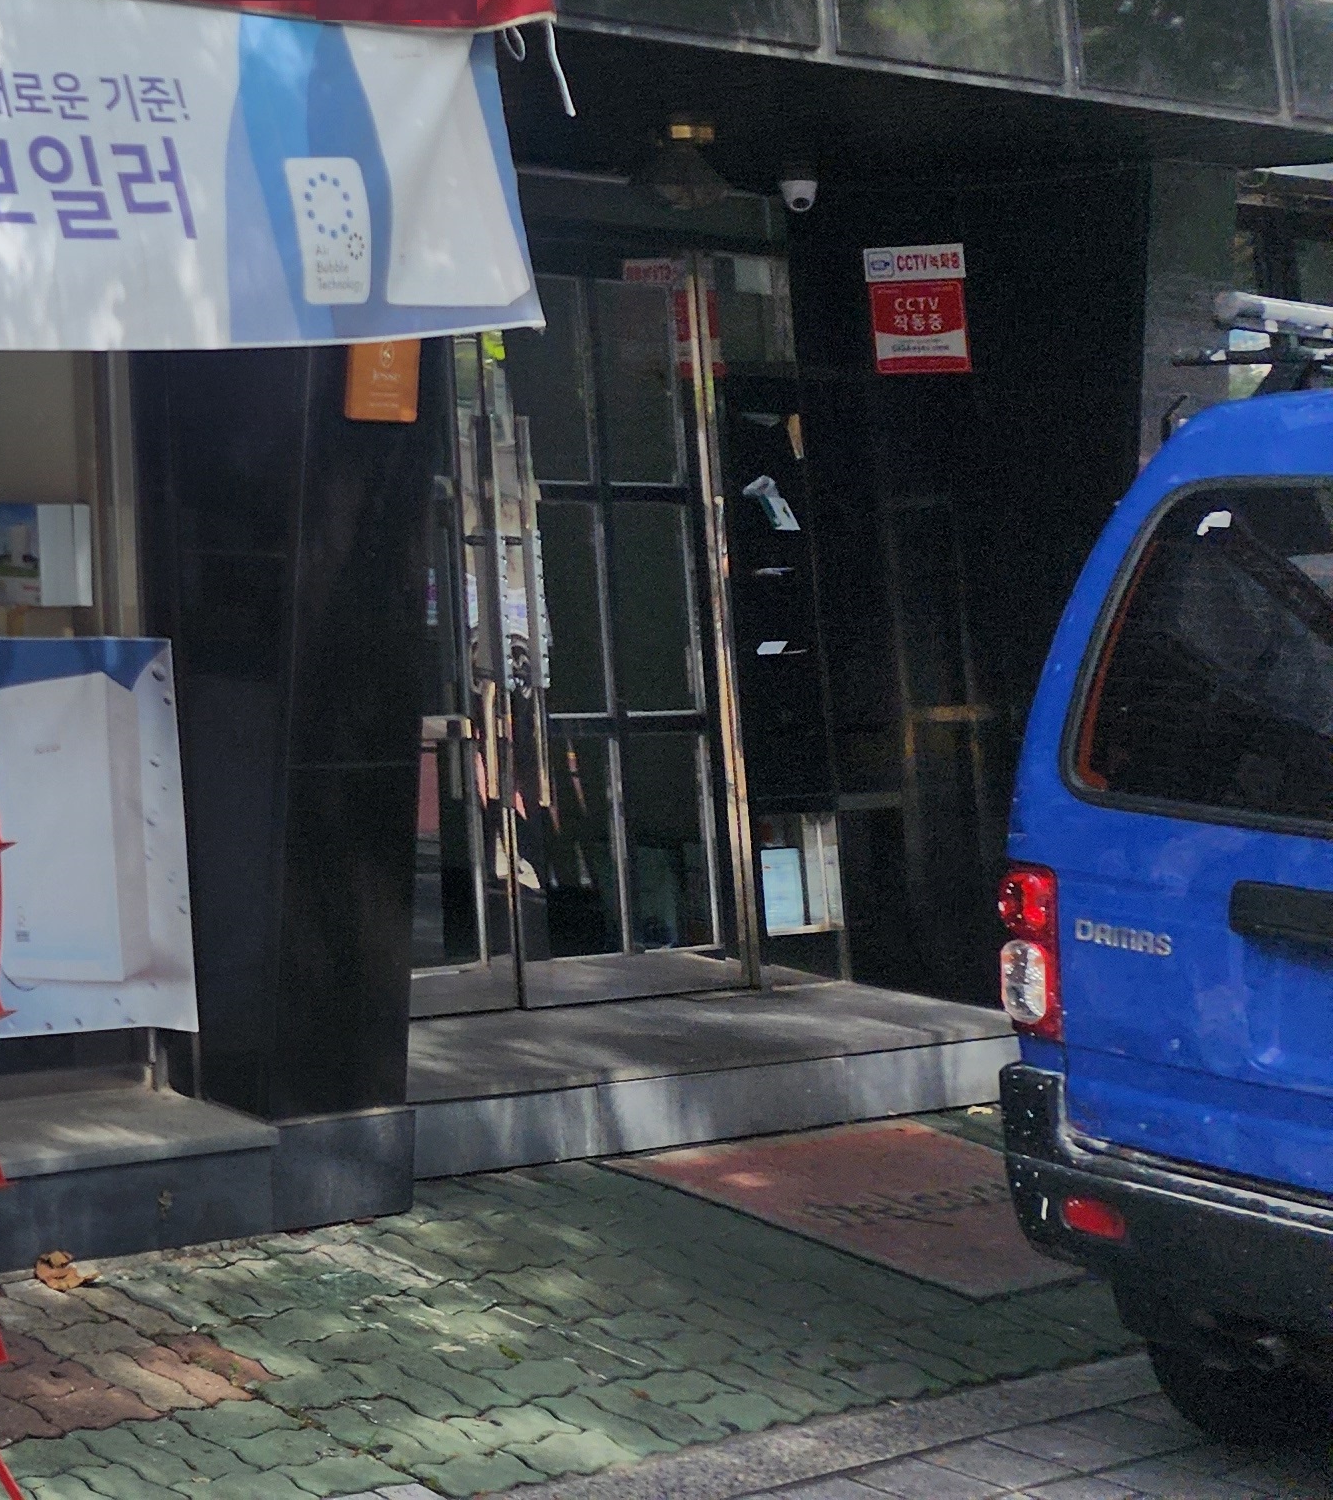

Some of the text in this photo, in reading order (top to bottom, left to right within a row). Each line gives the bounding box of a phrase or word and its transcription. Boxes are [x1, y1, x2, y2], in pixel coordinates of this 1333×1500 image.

[98, 74, 190, 122] 기준!
[894, 297, 939, 312] CCTV
[1075, 918, 1172, 956] DAMAS
